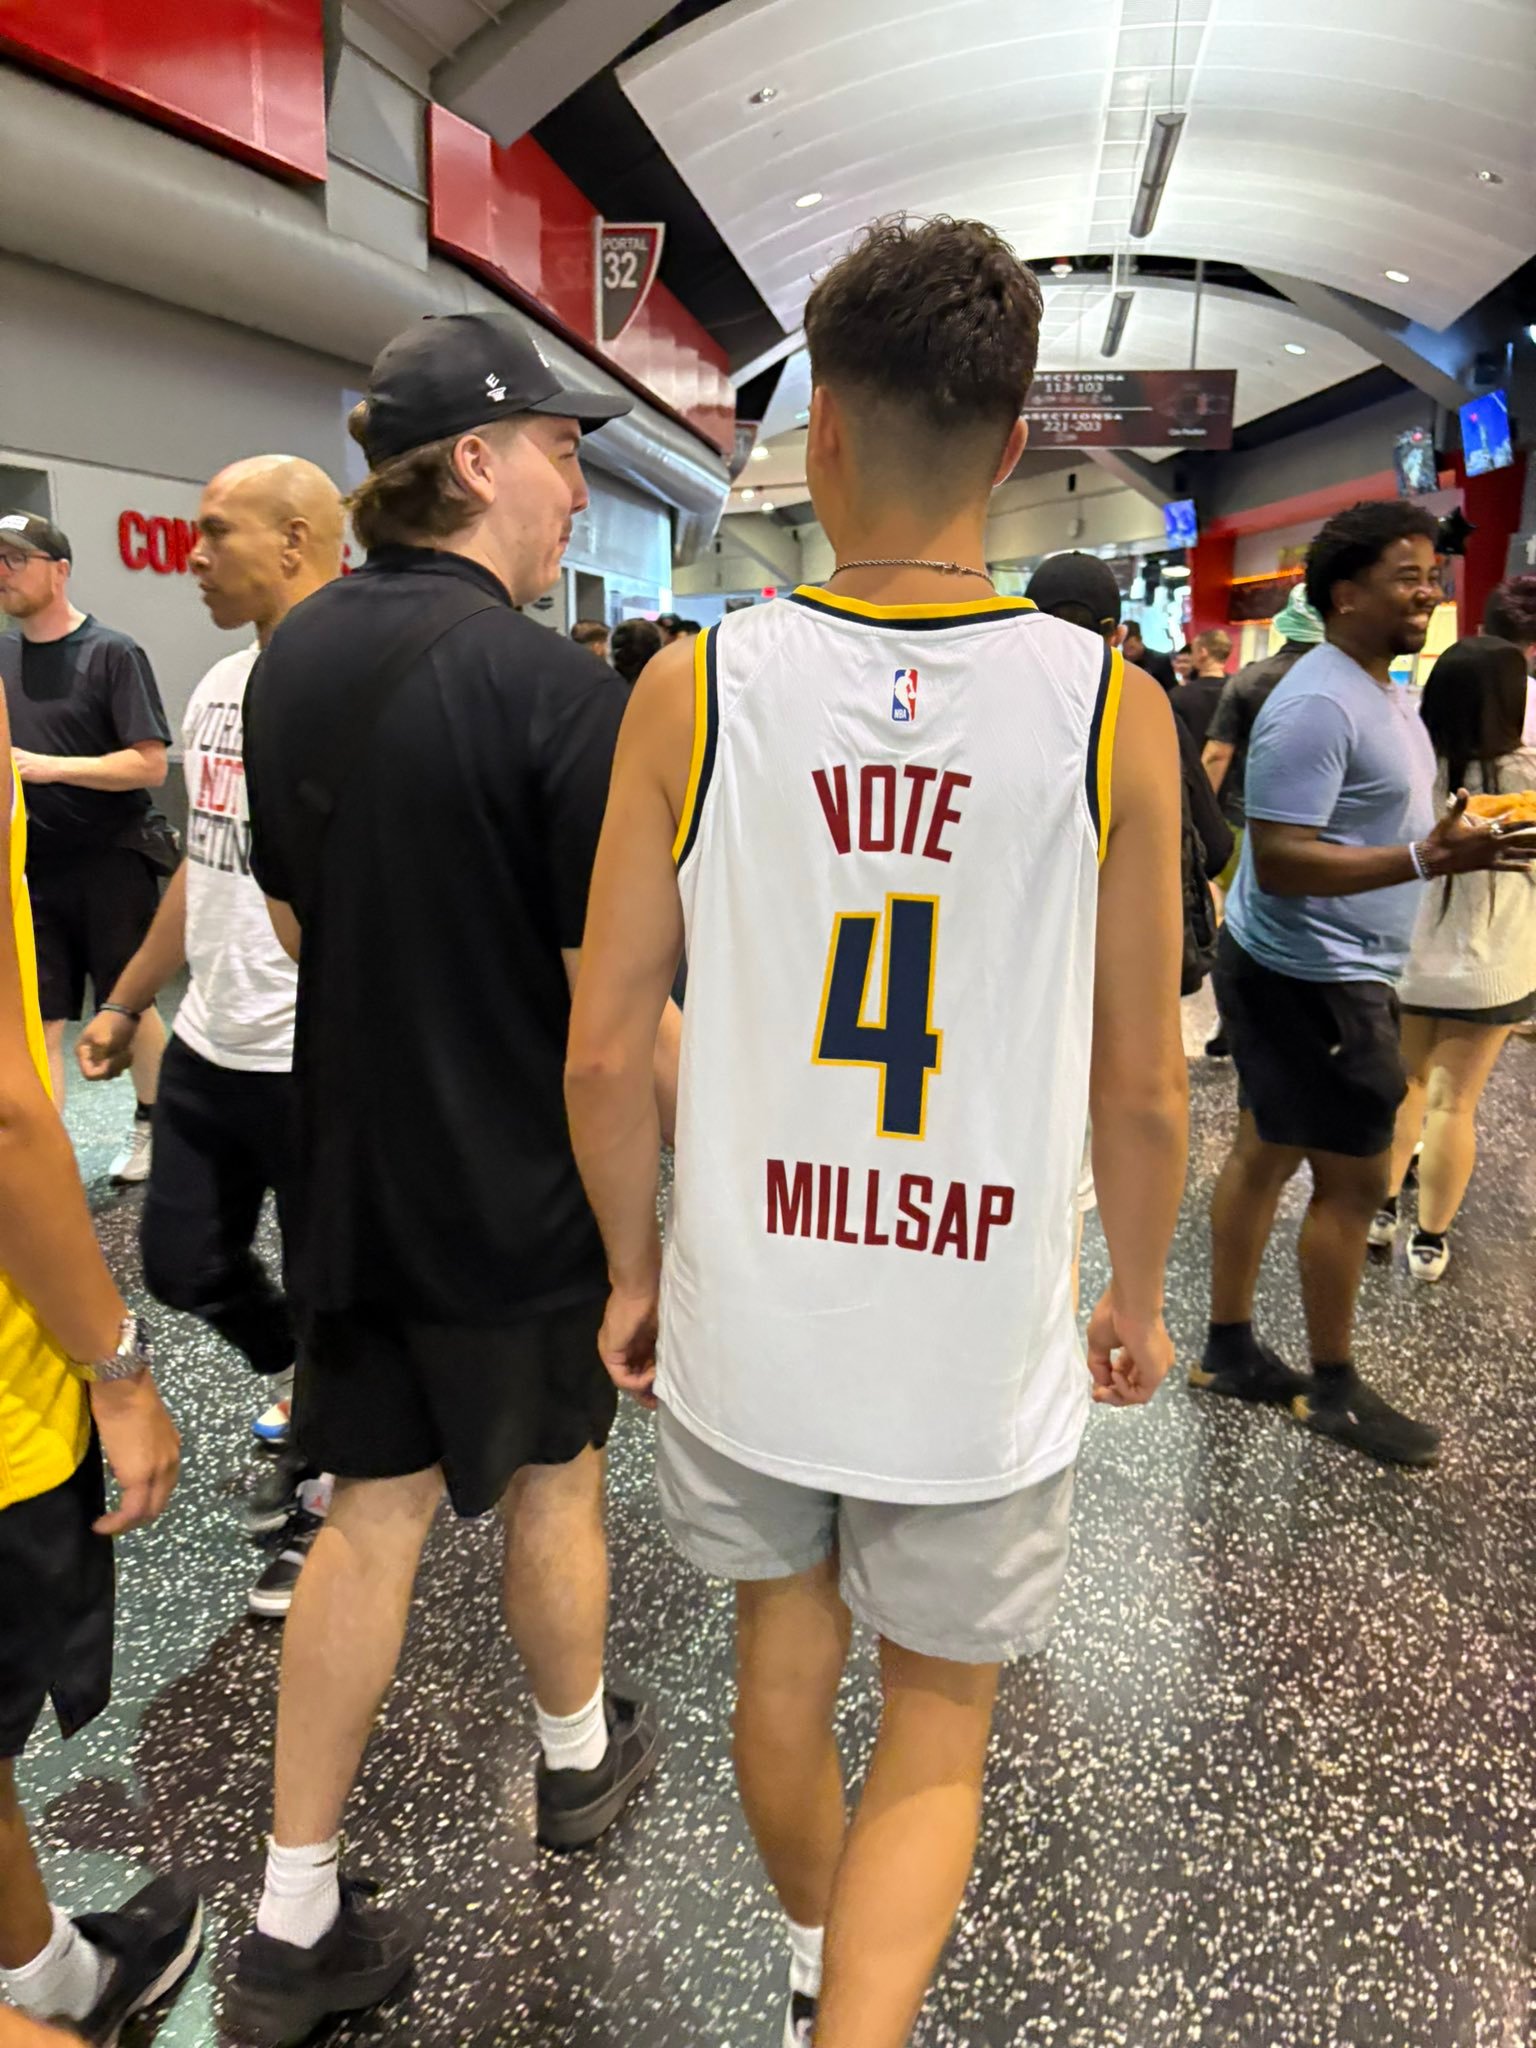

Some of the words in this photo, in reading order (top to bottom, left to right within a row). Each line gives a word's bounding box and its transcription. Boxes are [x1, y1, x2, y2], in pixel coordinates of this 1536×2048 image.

[603, 237, 649, 251] PORTAL
[604, 251, 638, 289] 32
[1045, 382, 1104, 393] 113-103
[1042, 422, 1102, 432] 221-203
[893, 708, 907, 720] NBA
[811, 764, 972, 863] VOTE
[811, 891, 944, 1141] 4
[766, 1158, 1015, 1262] MILLSAP
